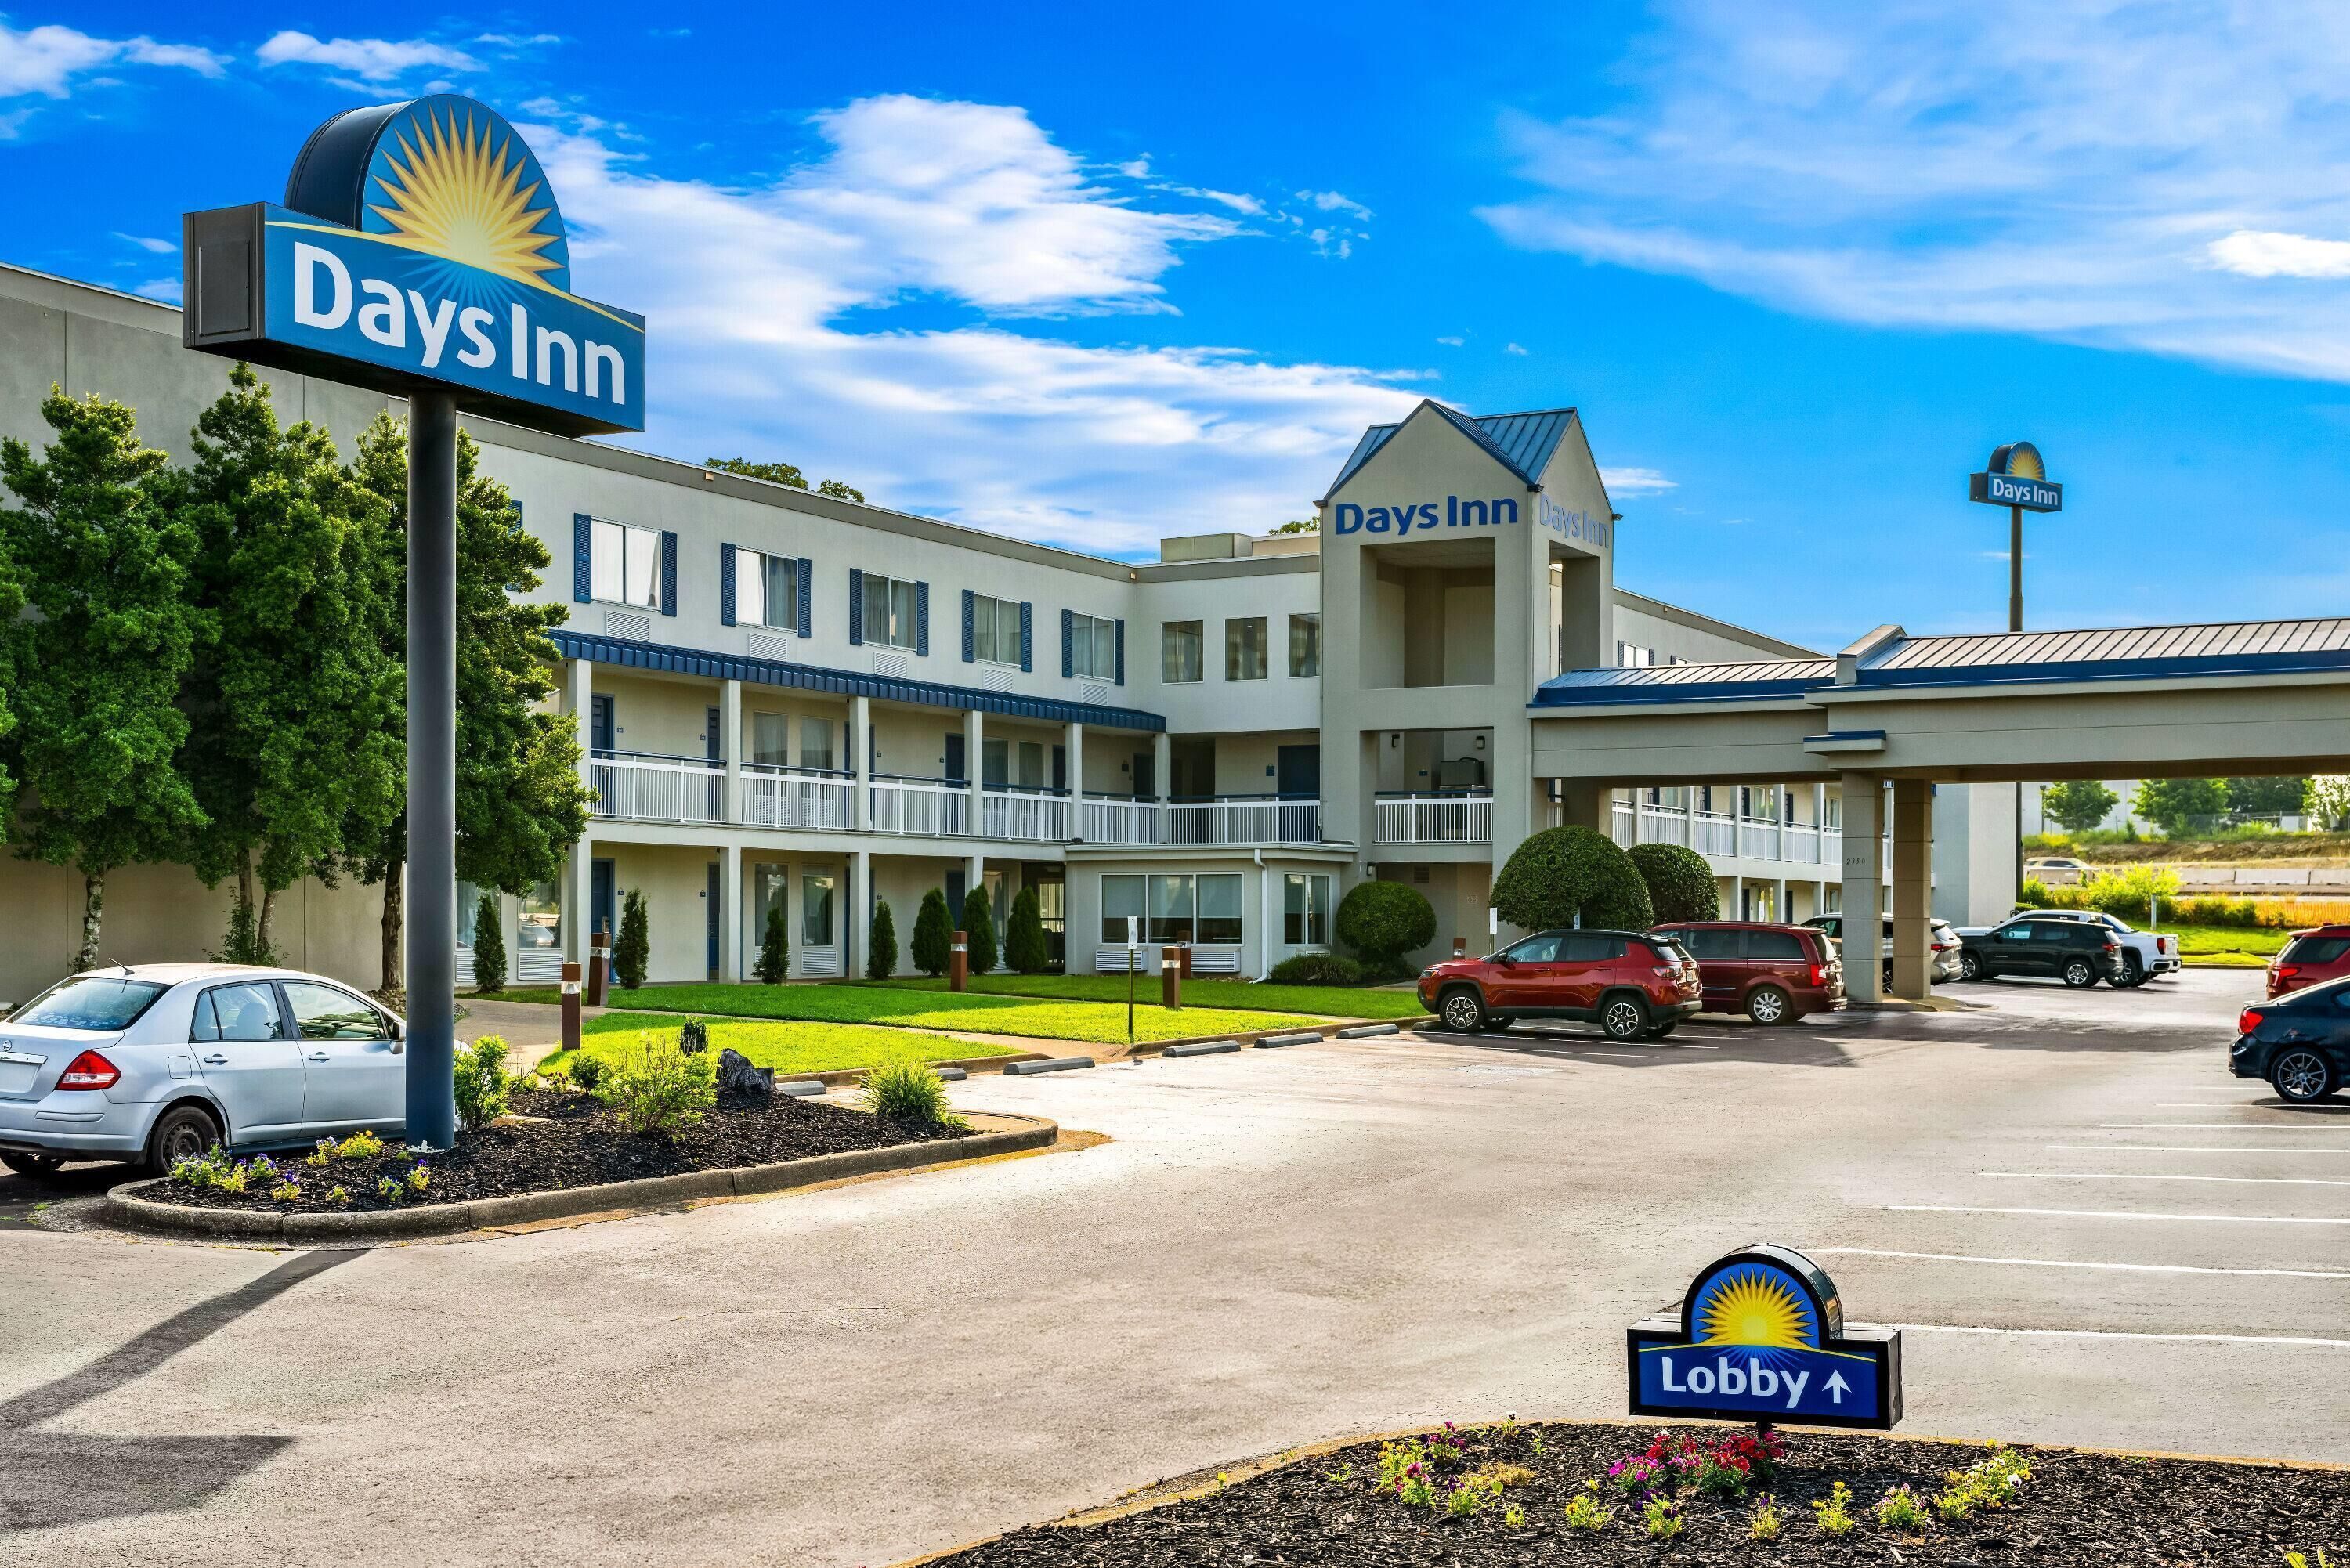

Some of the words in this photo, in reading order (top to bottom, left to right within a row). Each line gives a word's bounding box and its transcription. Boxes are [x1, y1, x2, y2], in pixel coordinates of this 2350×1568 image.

[294, 240, 497, 369] Days
[512, 302, 625, 406] Inn
[1336, 502, 1439, 536] Days
[1448, 495, 1518, 527] Inn
[1993, 478, 2031, 502] Days
[2033, 485, 2058, 506] Inn
[1540, 493, 1580, 539] Days
[1583, 510, 1609, 549] Inn
[1661, 1356, 1810, 1409] Lobby
